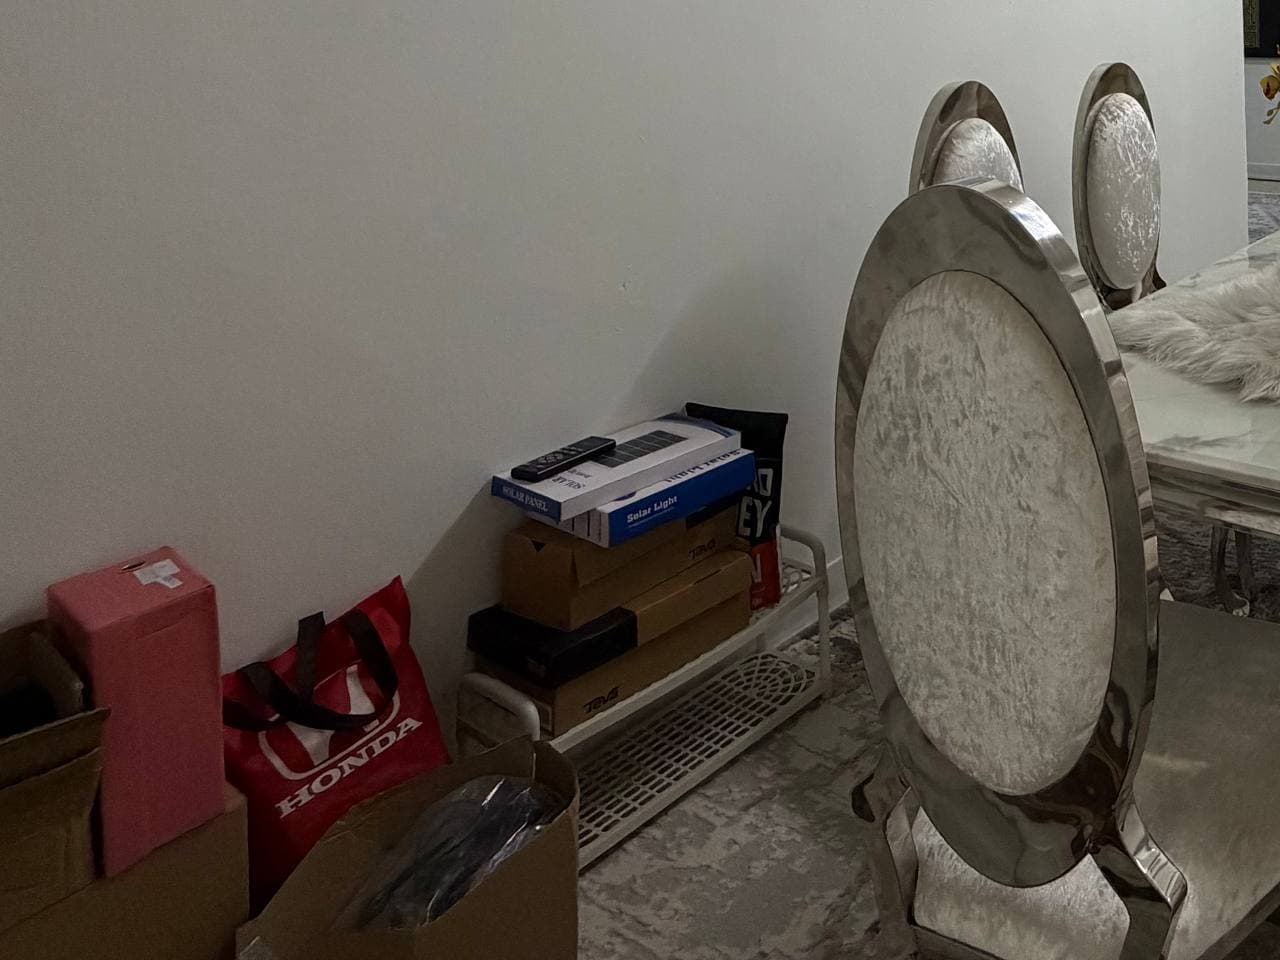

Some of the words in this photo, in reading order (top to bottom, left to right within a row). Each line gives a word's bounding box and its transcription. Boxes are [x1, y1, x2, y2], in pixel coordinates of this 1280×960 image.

[626, 506, 652, 524] Solar
[653, 495, 678, 513] Light
[274, 717, 424, 819] HONDA
